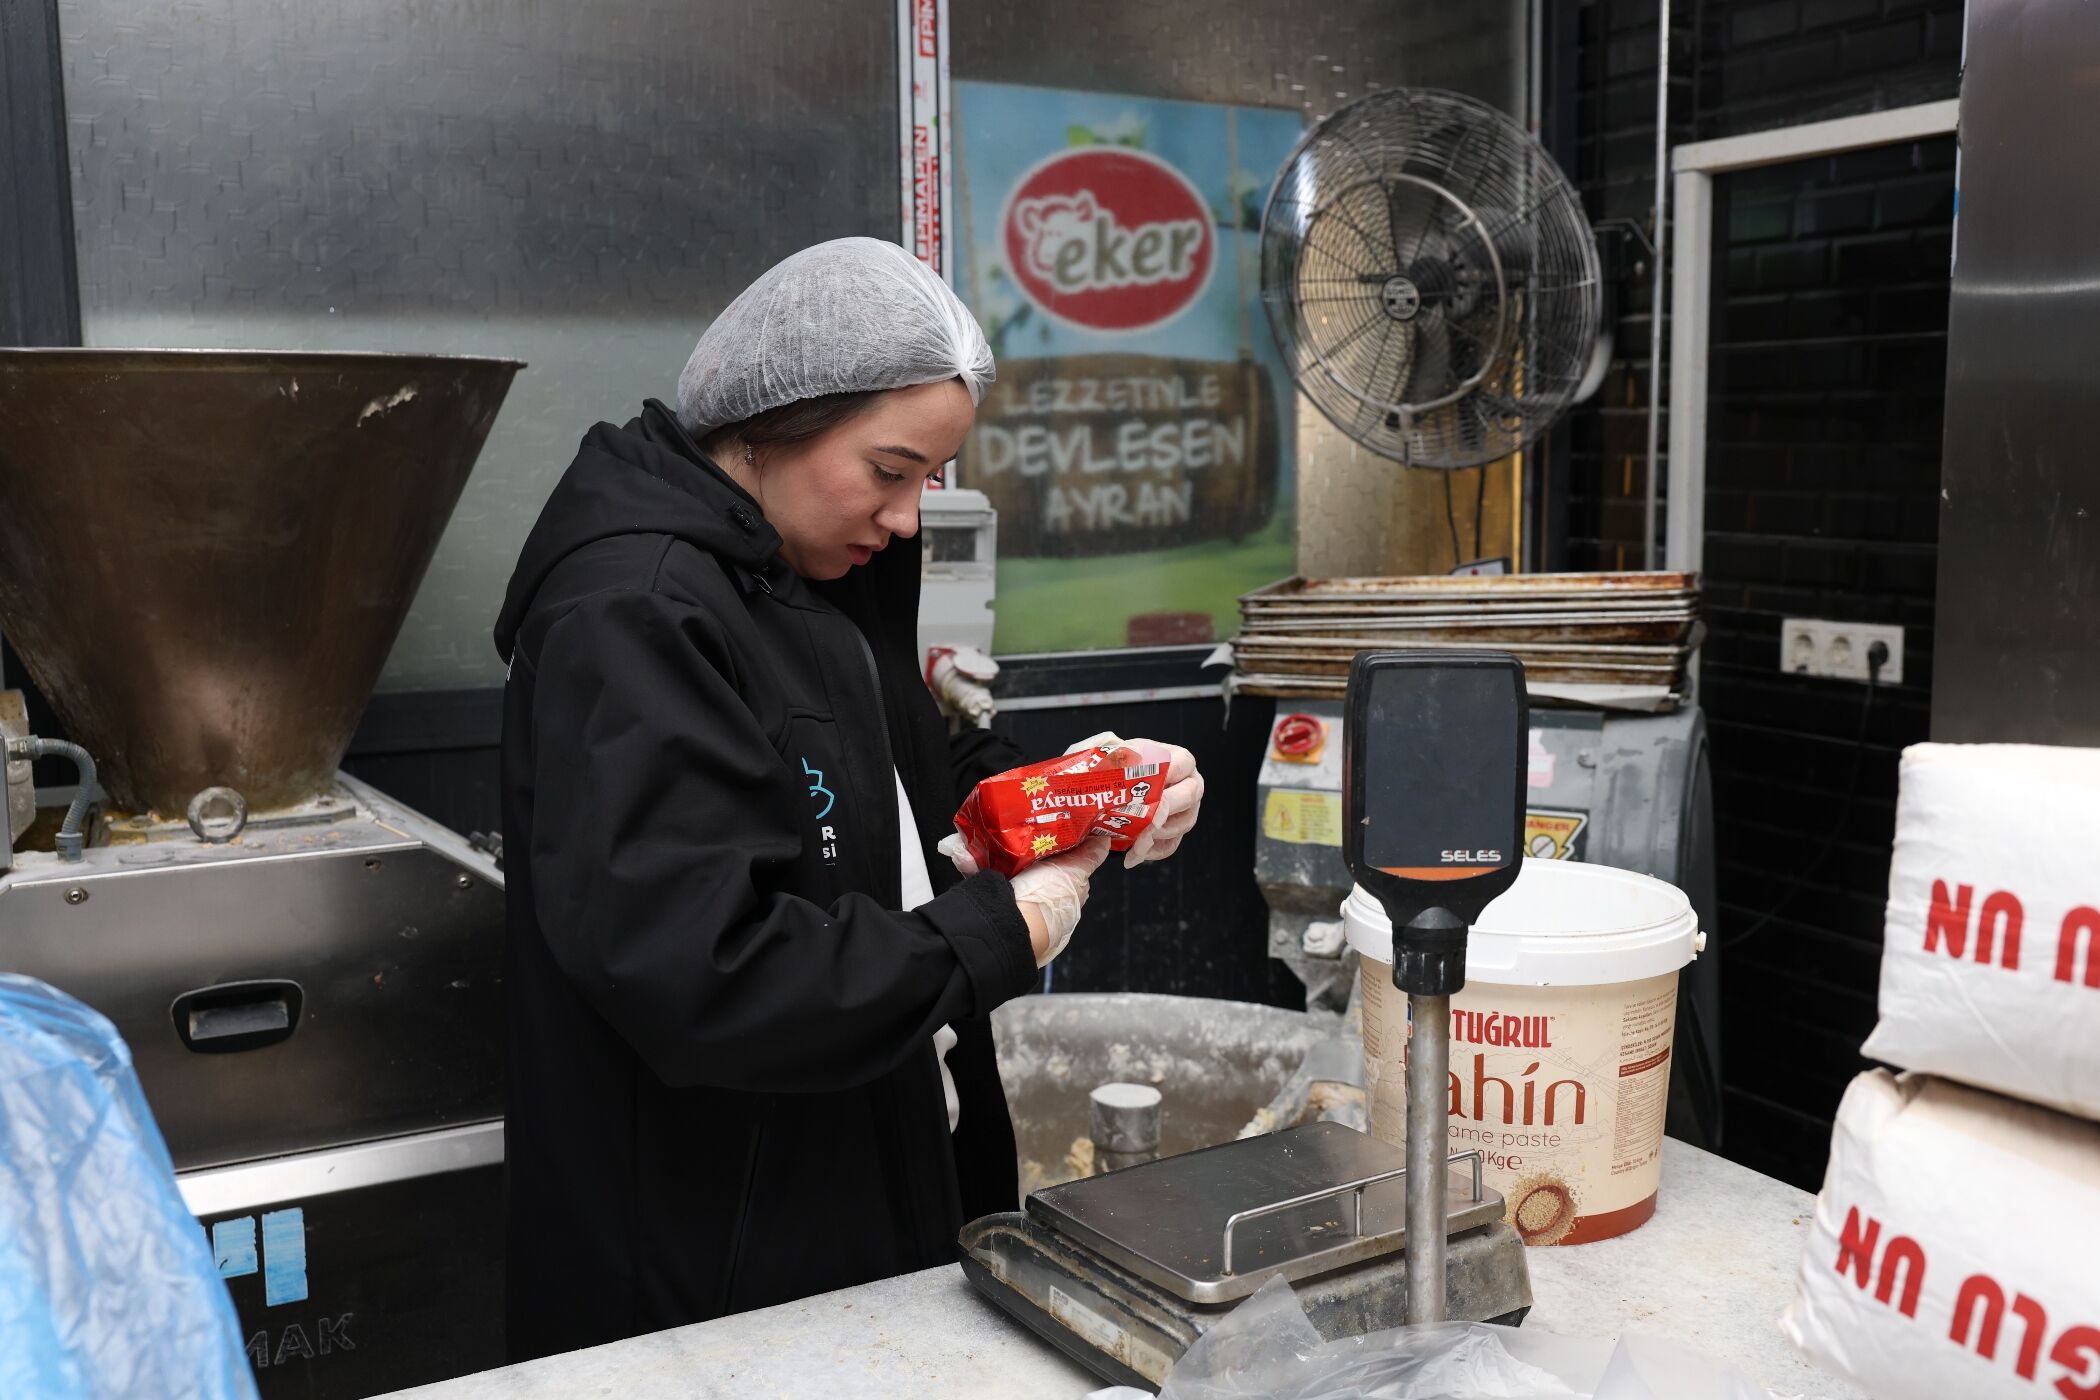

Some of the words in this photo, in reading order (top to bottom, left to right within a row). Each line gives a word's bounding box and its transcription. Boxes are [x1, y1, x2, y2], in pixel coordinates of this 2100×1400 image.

[914, 128, 928, 240] PIMAPEN
[1054, 216, 1197, 287] eker
[977, 416, 1244, 479] DEVLEŞEN
[1047, 480, 1193, 532] AYRAN
[1031, 788, 1127, 811] Pakmaya
[1526, 819, 1569, 832] ANGER
[1440, 849, 1502, 863] SELES
[1923, 877, 2026, 972] UN
[1450, 1009, 1552, 1048] TUĞRUL
[1448, 1053, 1586, 1126] ahin
[1448, 1125, 1494, 1144] ame
[1502, 1132, 1561, 1149] paste
[1834, 1204, 1928, 1321] UN
